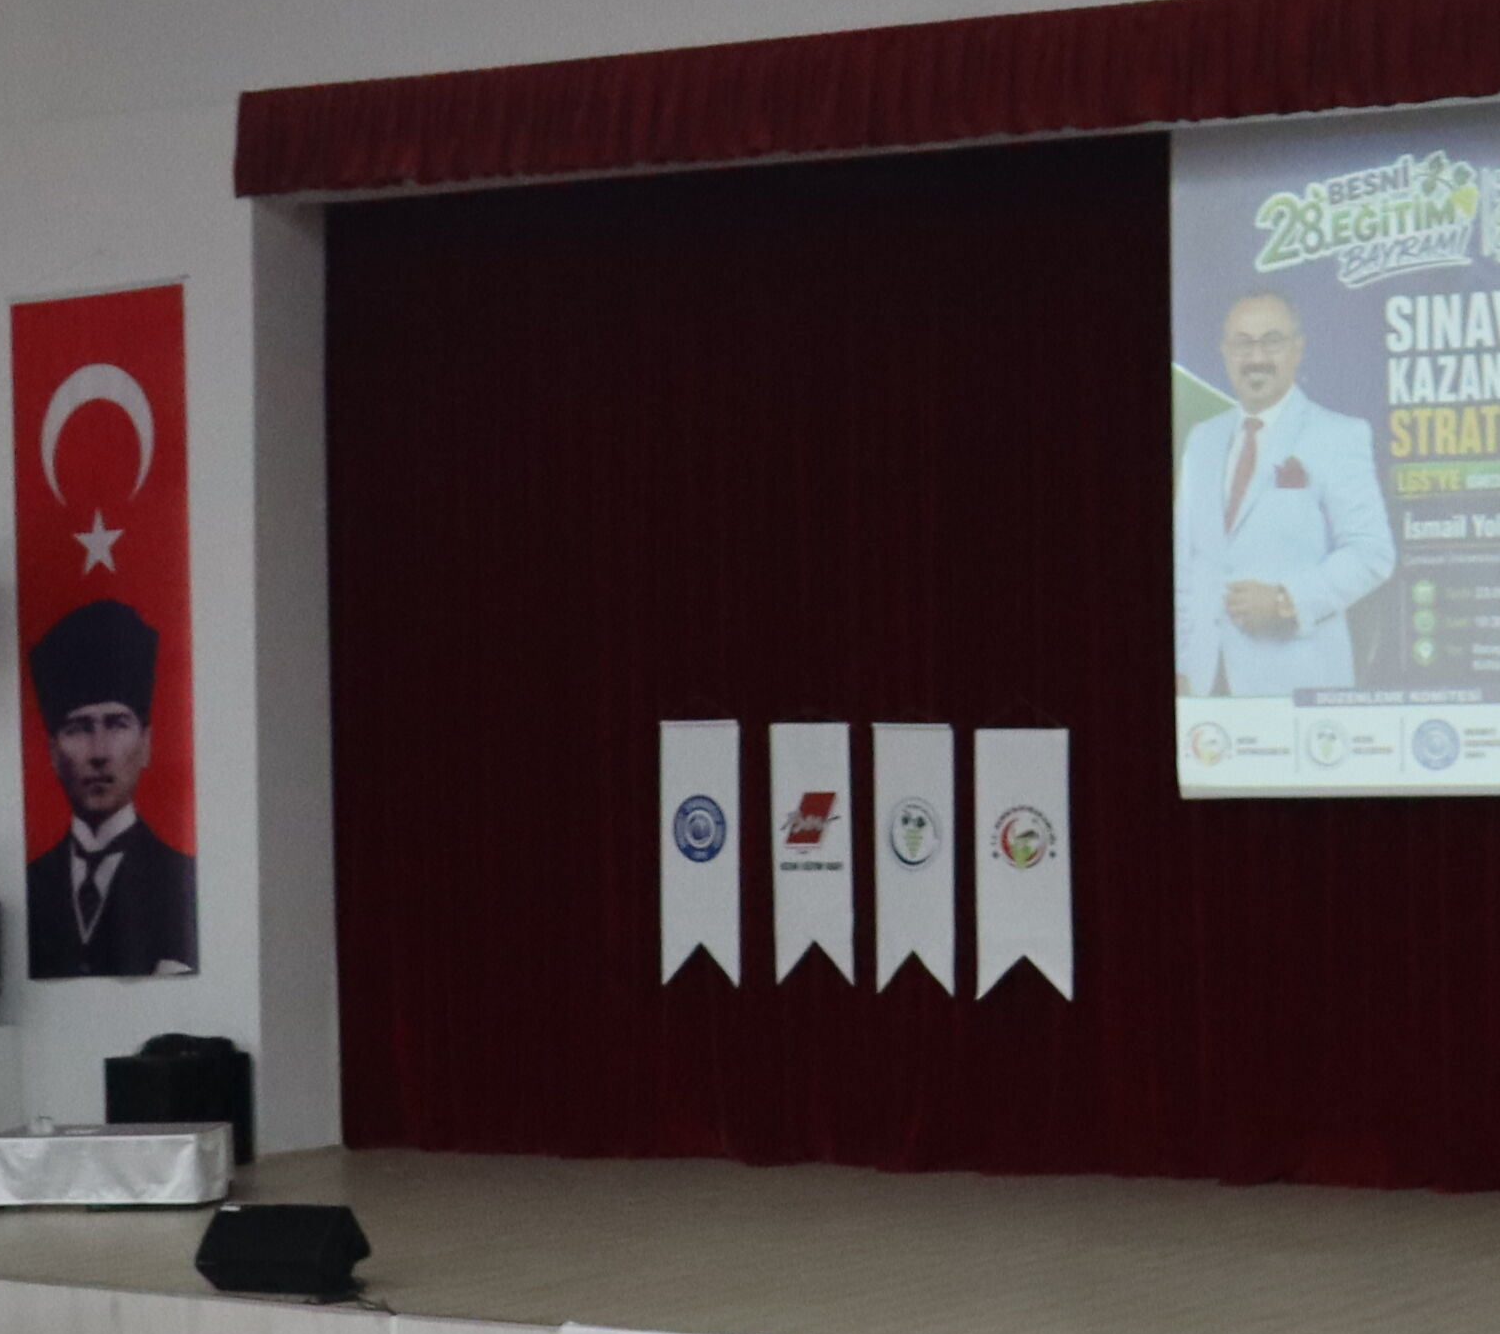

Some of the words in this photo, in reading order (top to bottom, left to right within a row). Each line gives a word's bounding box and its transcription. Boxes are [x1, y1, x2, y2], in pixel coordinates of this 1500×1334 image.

[1328, 159, 1409, 205] BESNİ
[1332, 194, 1456, 245] EĞİTİM
[1404, 511, 1467, 540] İsmail
